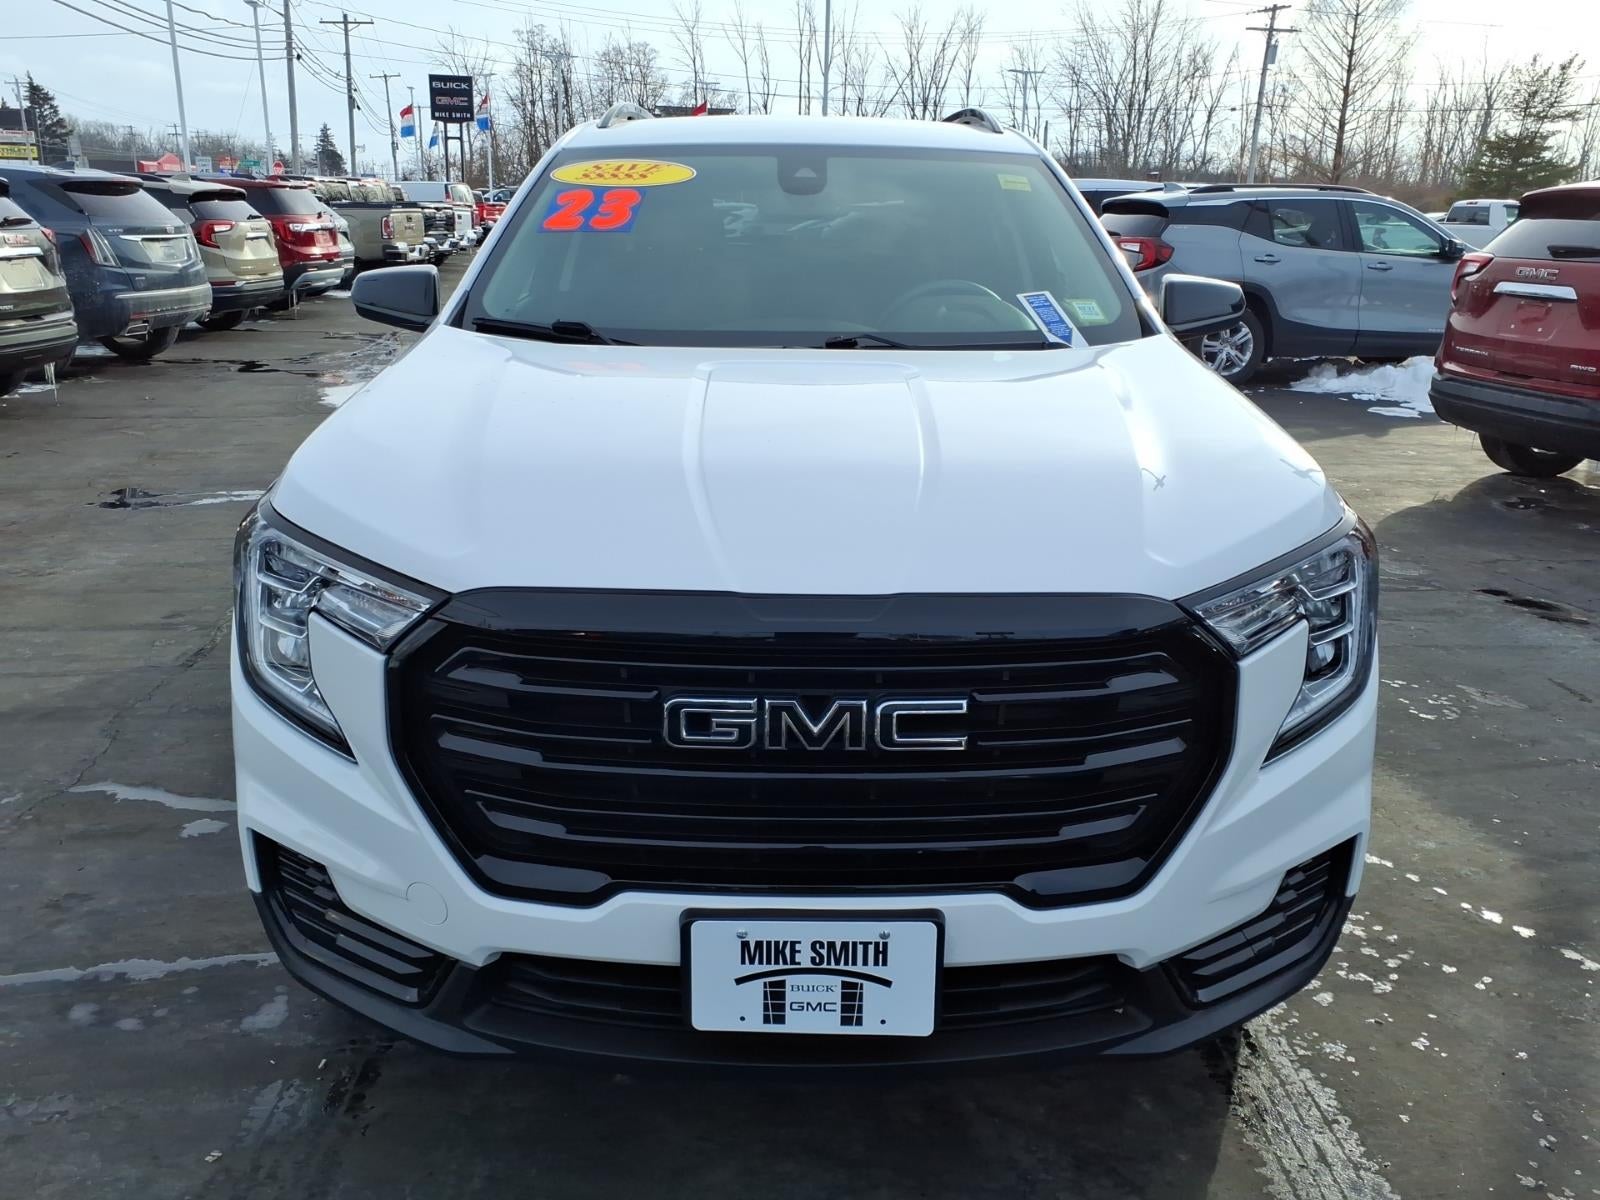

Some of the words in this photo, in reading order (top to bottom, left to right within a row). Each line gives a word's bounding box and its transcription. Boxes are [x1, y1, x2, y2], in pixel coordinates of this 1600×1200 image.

[432, 81, 471, 90] BUICK
[435, 96, 469, 106] GMC
[452, 111, 471, 119] SMITH
[543, 188, 642, 231] 23
[1515, 266, 1560, 281] GMC
[663, 698, 968, 751] GMC
[740, 940, 802, 966] MIKE
[810, 940, 889, 967] SMITH
[790, 984, 836, 993] BUICK
[789, 1001, 837, 1012] GMC
